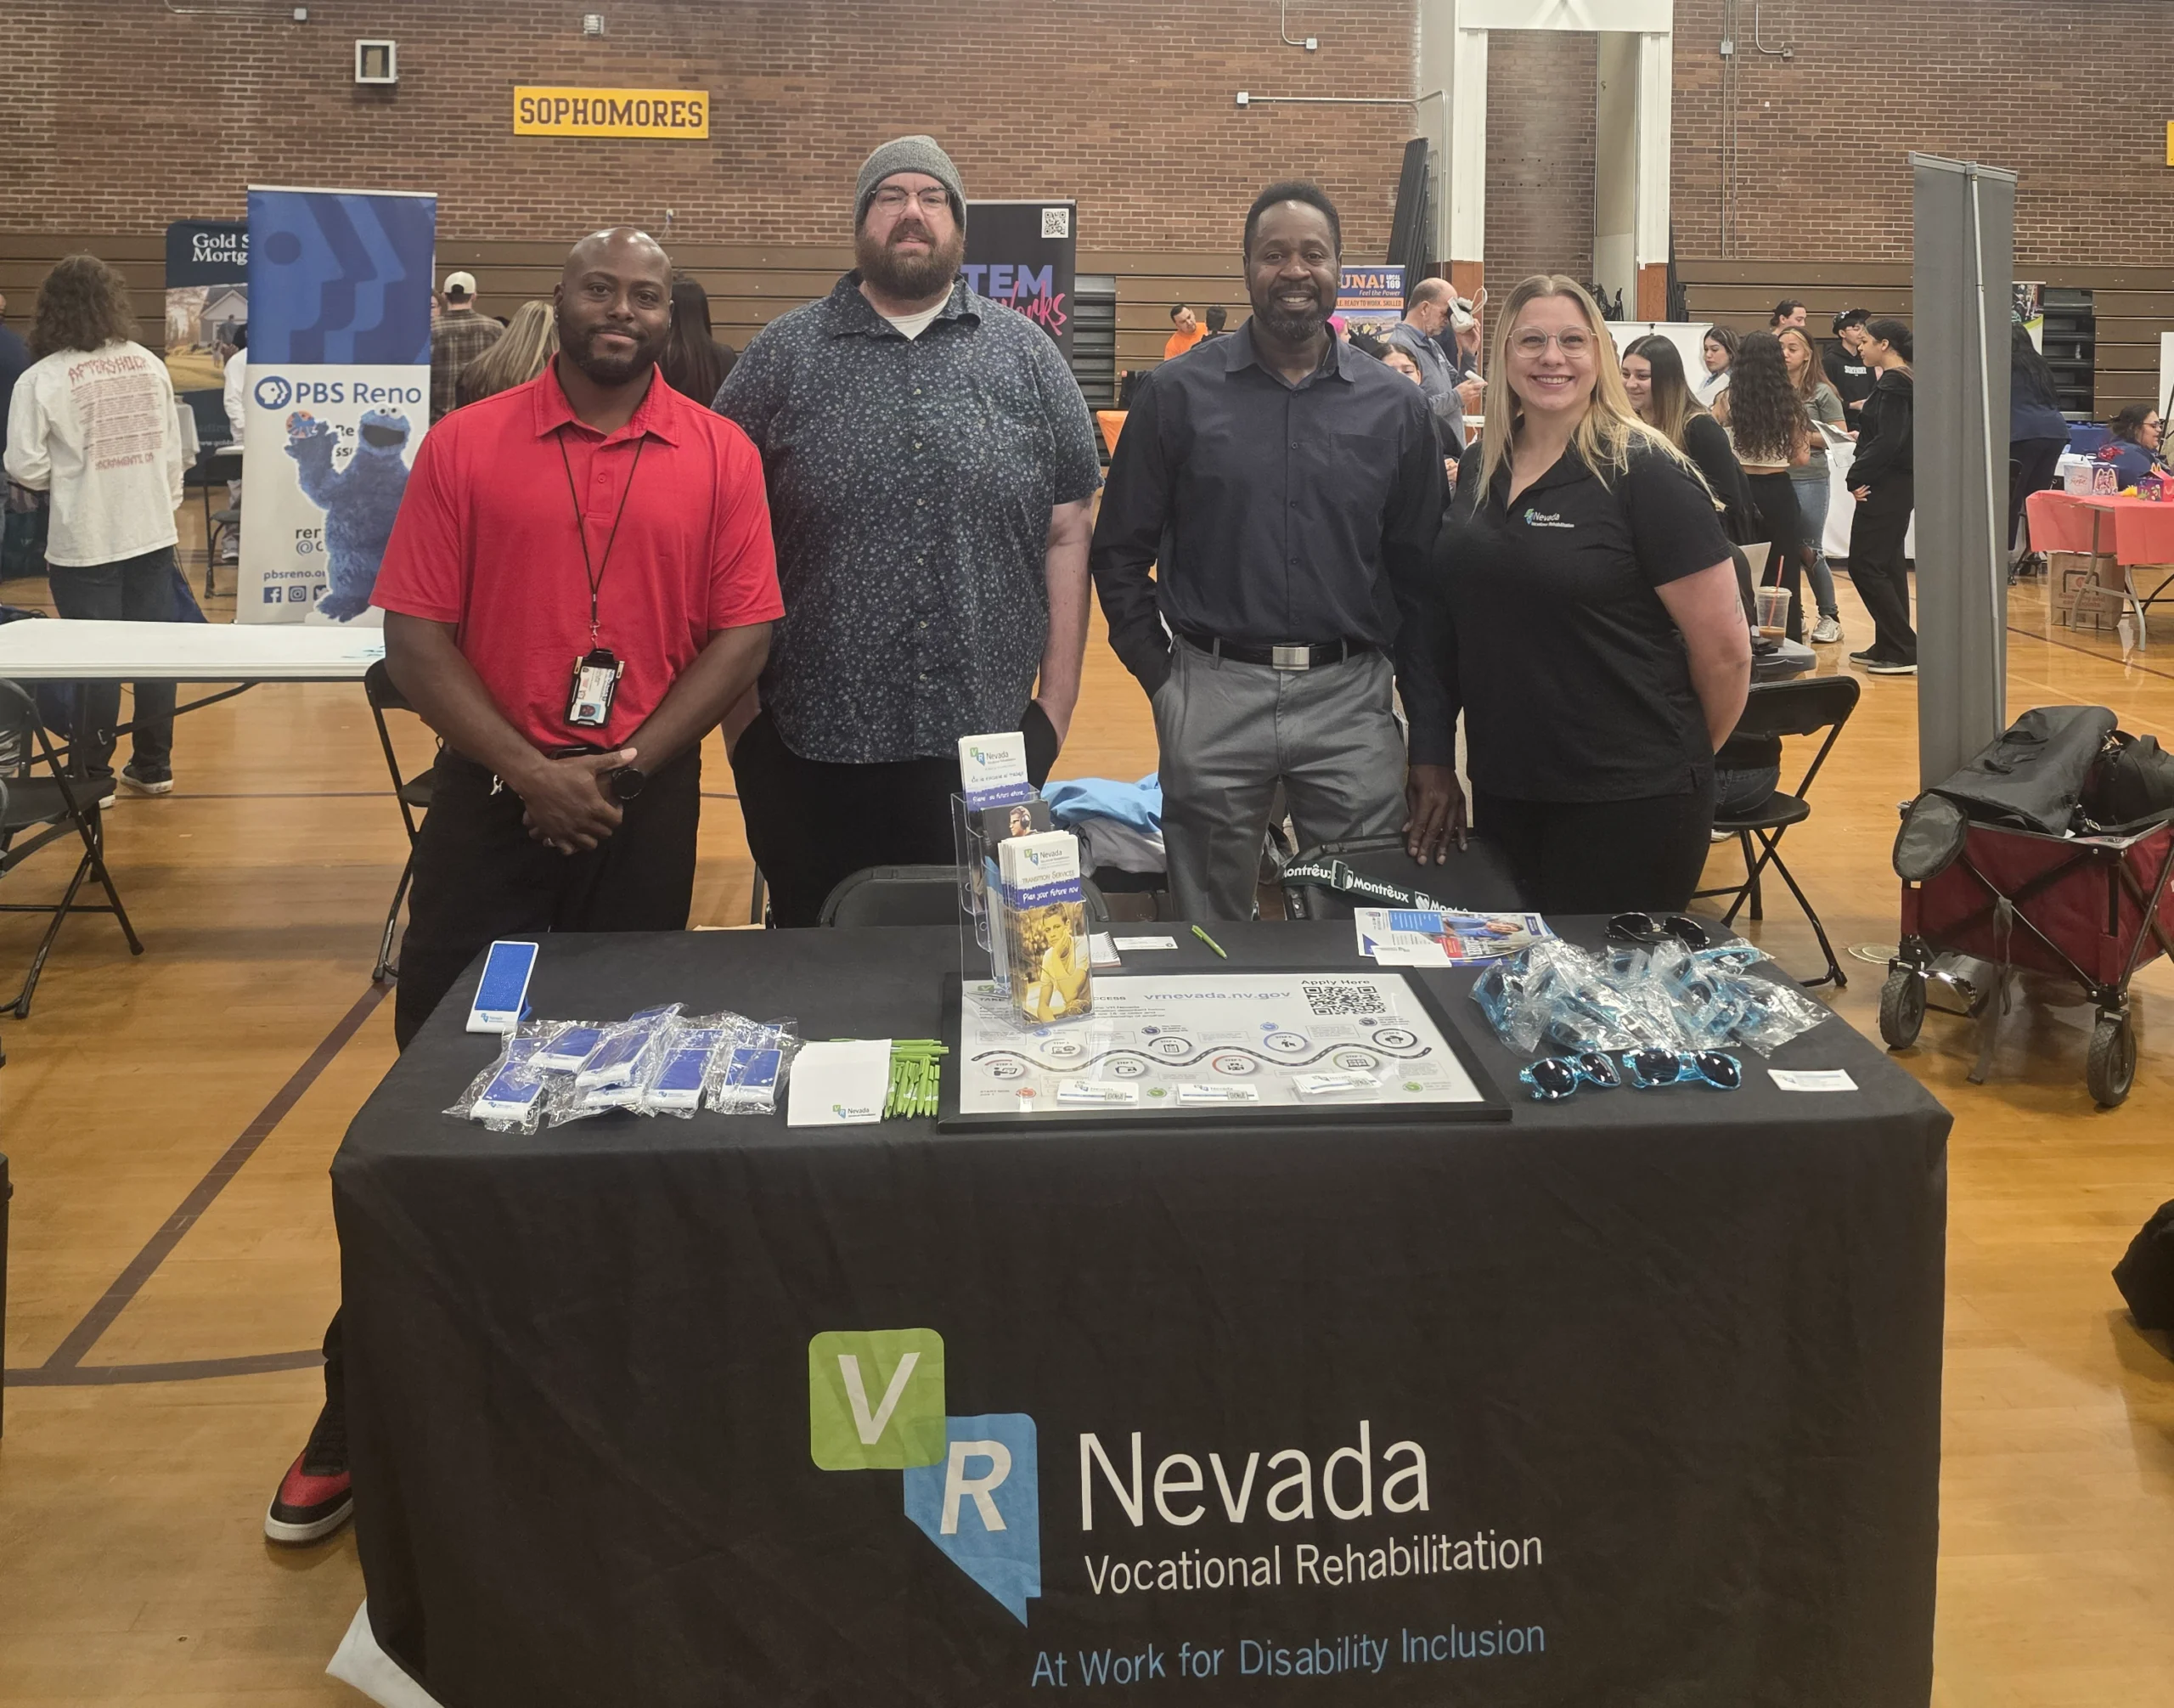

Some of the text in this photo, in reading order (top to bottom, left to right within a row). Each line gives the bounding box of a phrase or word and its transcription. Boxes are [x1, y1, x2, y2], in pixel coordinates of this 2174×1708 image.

[520, 98, 703, 128] SOPHOMORES
[193, 233, 236, 248] Gold
[192, 247, 248, 265] Mortg
[960, 264, 1053, 297] TEM
[1340, 274, 1384, 289] UNA!
[296, 382, 421, 403] PBS Reno
[1533, 511, 1560, 521] Nevada
[263, 569, 325, 581] pbsreno.o
[986, 751, 1009, 760] Nevada
[1040, 848, 1062, 859] Nevada
[1023, 893, 1036, 904] Plan
[1037, 890, 1048, 900] your
[1050, 888, 1067, 897] future
[1143, 991, 1291, 1000] vrnevada.nv.gov
[837, 1351, 921, 1446] V
[1079, 1419, 1430, 1531] Nevada
[939, 1440, 1012, 1535] R
[1084, 1529, 1543, 1596] Vocational Rehabilitation
[1032, 1621, 1546, 1688] At Work for Disability Inclusion
